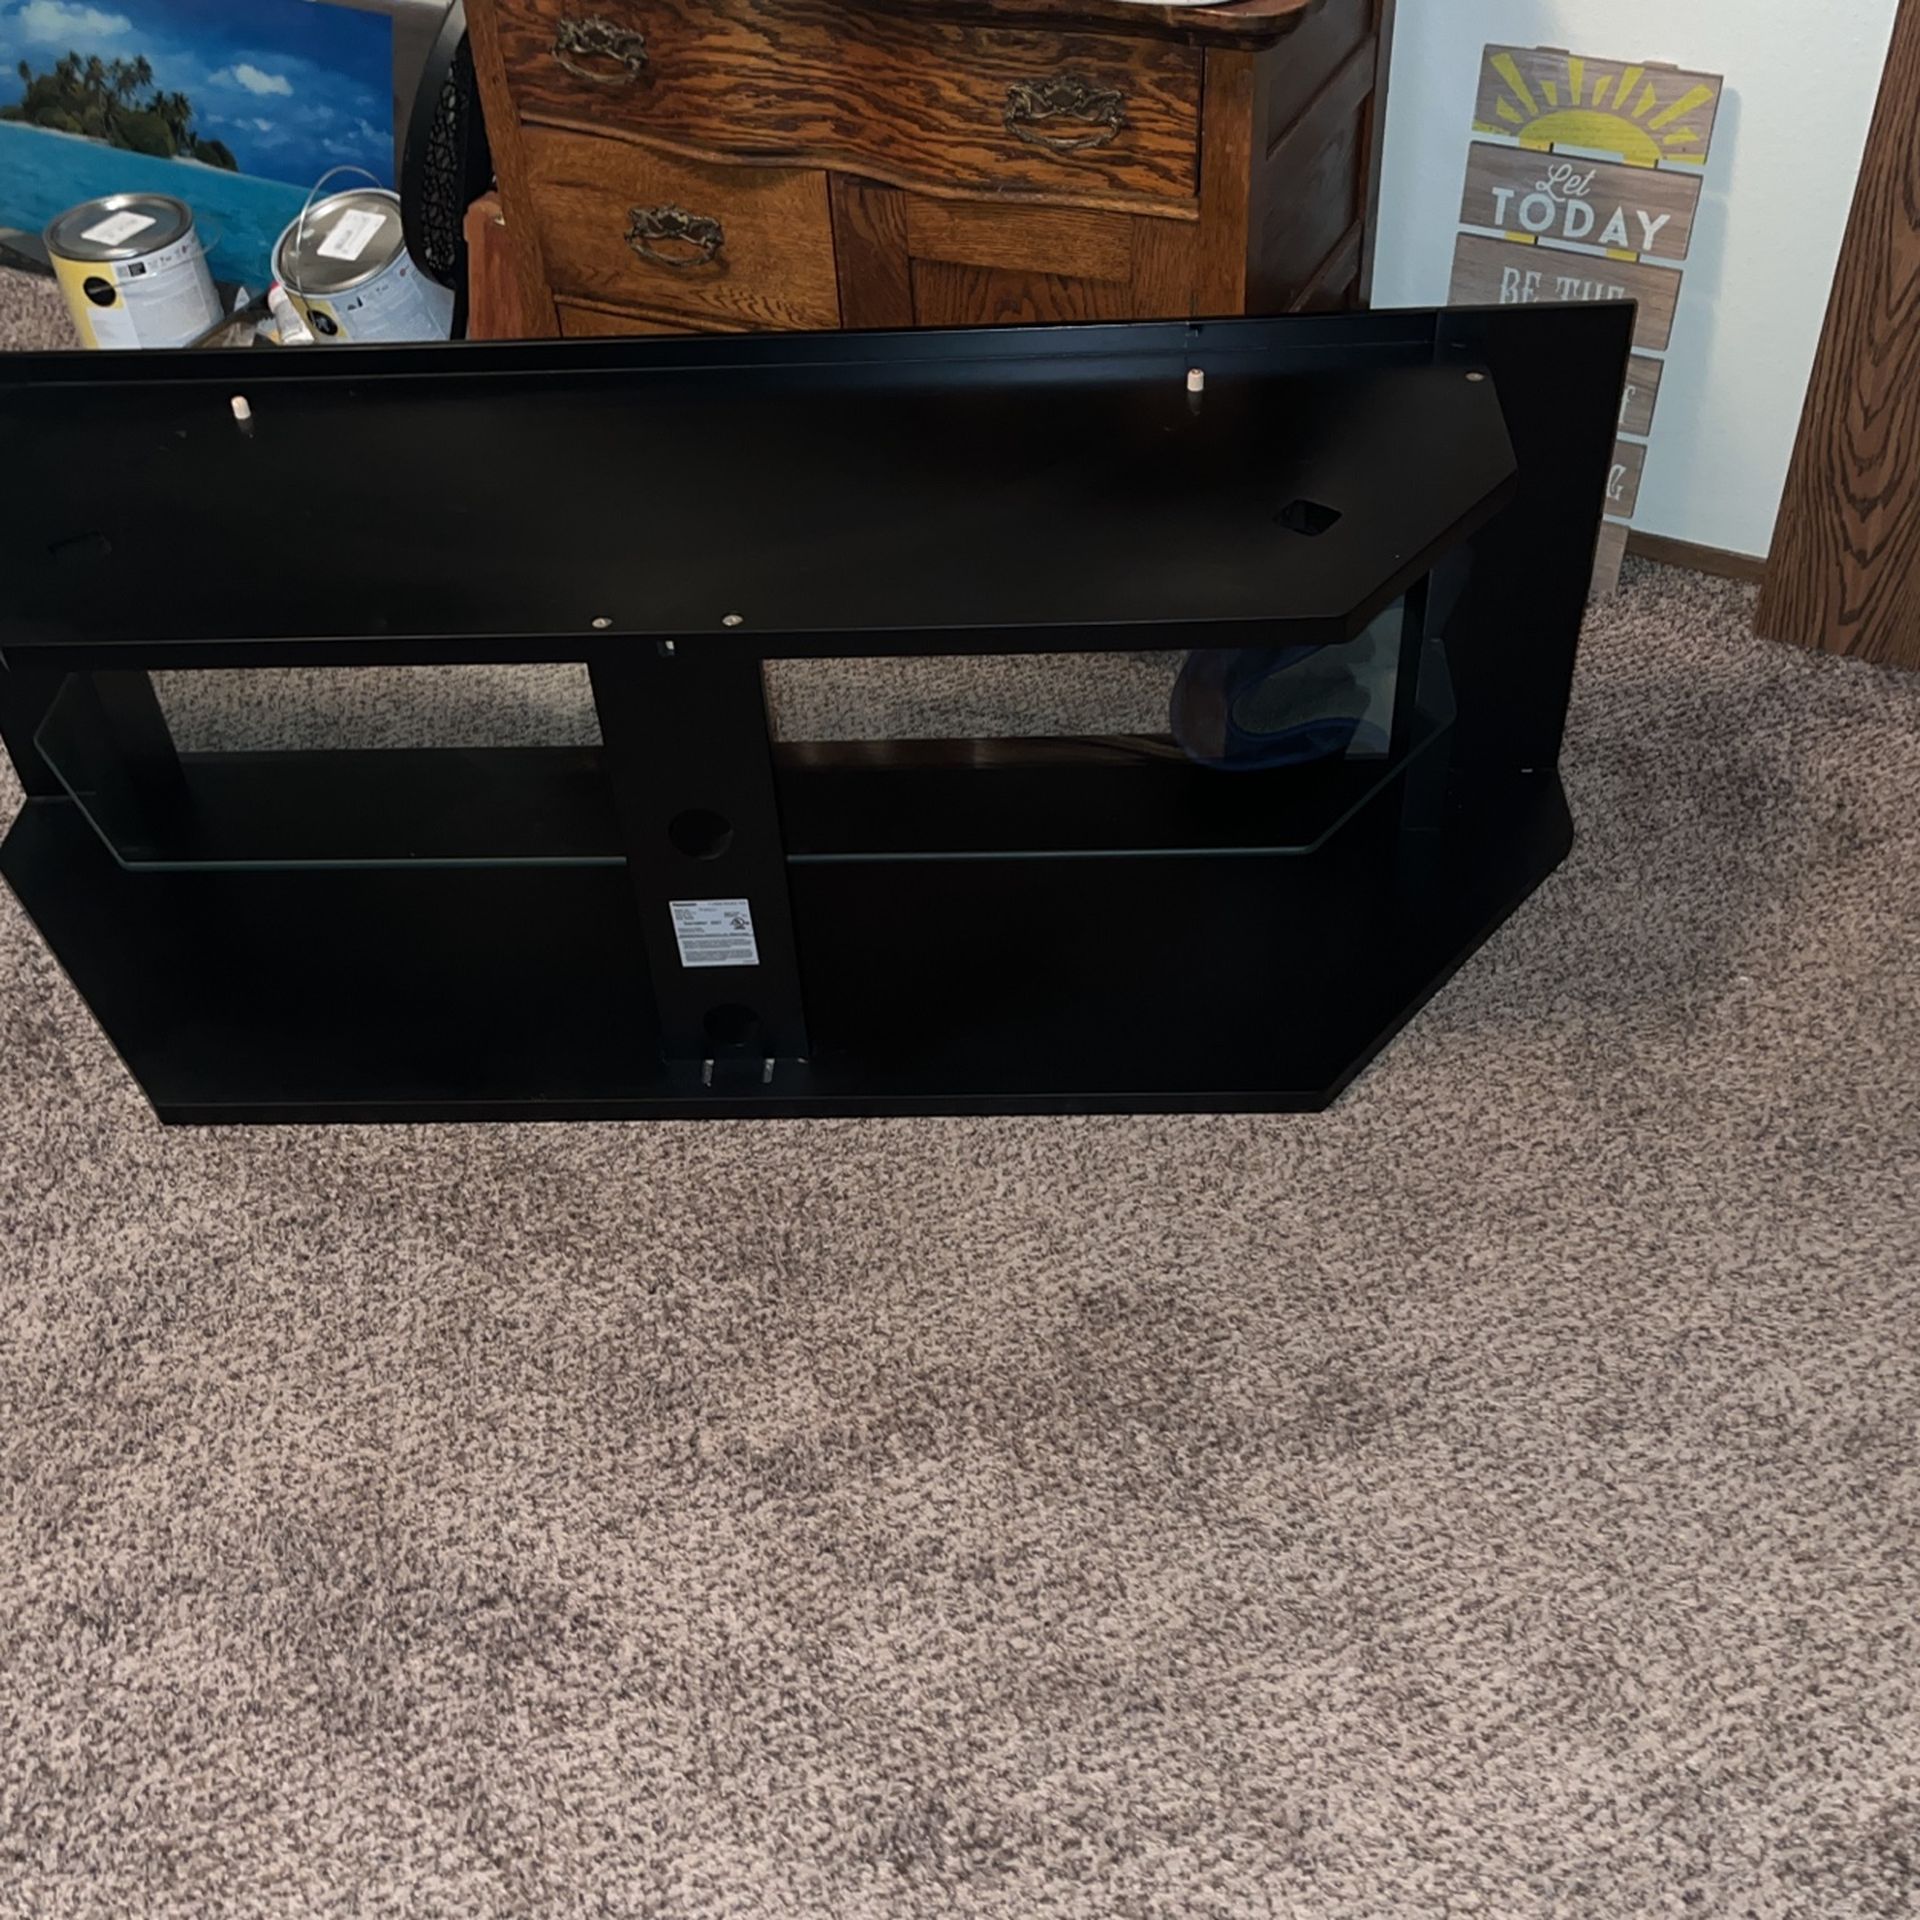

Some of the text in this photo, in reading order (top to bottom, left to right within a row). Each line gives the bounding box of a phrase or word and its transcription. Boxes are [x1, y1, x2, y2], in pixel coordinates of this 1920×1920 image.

[1535, 163, 1597, 203] Let
[1491, 186, 1672, 251] TODAY
[1499, 266, 1543, 304] BE
